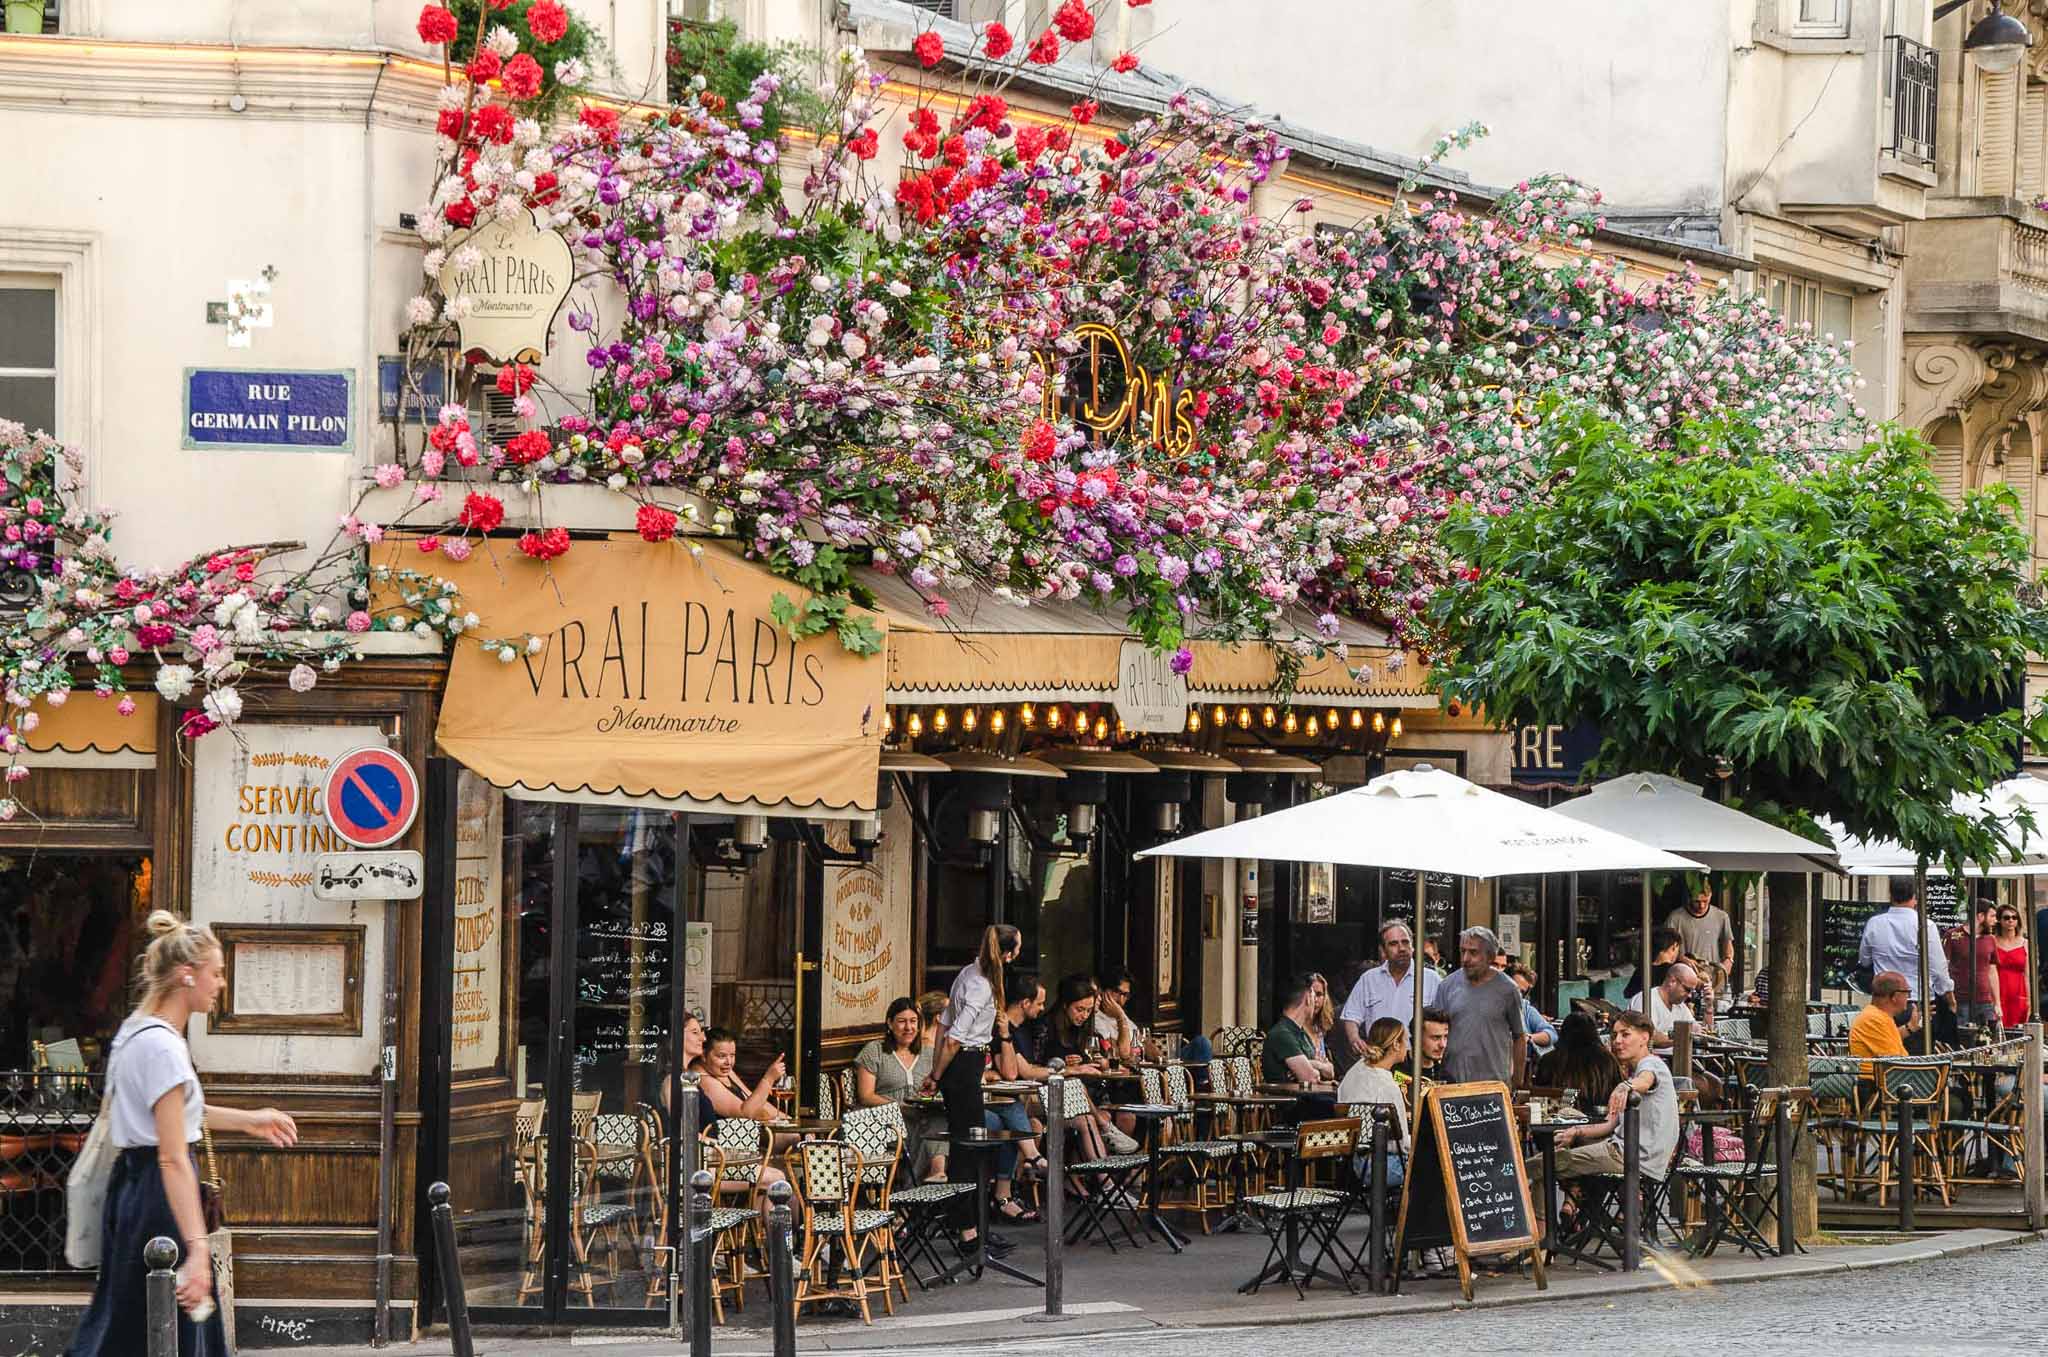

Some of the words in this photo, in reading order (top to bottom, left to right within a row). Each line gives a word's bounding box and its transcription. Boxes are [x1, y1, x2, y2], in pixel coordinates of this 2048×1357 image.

[506, 256, 555, 294] PARIS
[472, 301, 533, 313] Montmartre
[248, 384, 291, 400] RUE
[191, 412, 279, 430] GERMAIN
[287, 415, 347, 432] PILON
[523, 602, 648, 700] VRAI
[680, 602, 824, 706] PARIS
[597, 705, 741, 734] Montmartre
[239, 784, 324, 816] SERVIC
[853, 922, 882, 954] MAISON
[832, 955, 862, 986] TOUTE
[863, 942, 893, 983] HEURE
